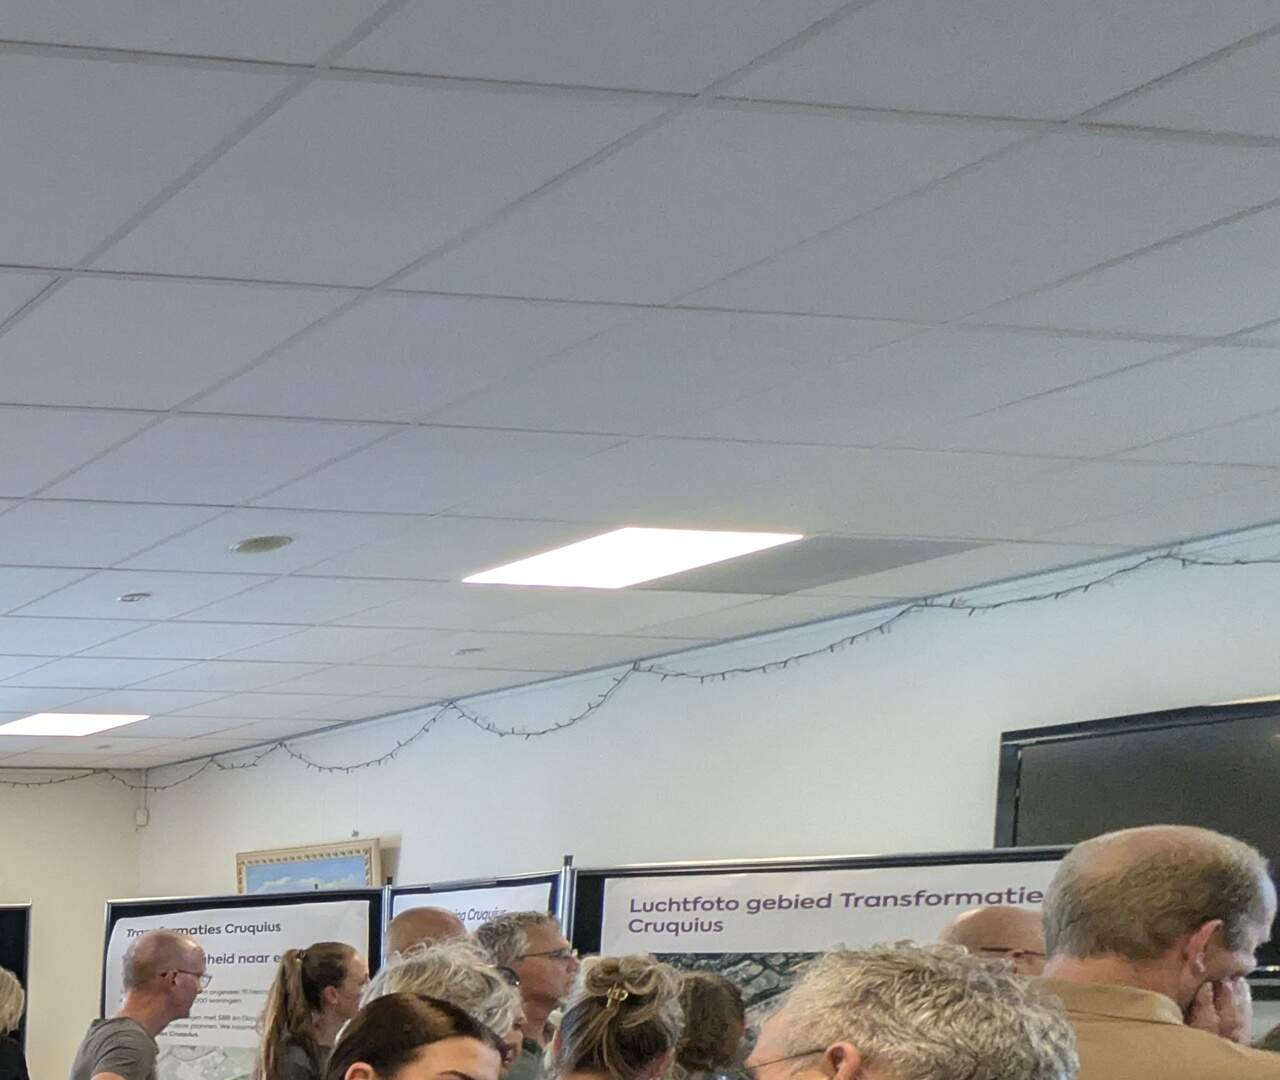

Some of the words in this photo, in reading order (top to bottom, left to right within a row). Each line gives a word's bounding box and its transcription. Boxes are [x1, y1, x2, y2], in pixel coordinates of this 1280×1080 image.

[630, 896, 739, 913] Luchtfoto
[746, 893, 832, 914] gebied
[225, 921, 281, 935] Cruquius
[628, 917, 724, 936] Cruquius
[238, 954, 269, 964] naar
